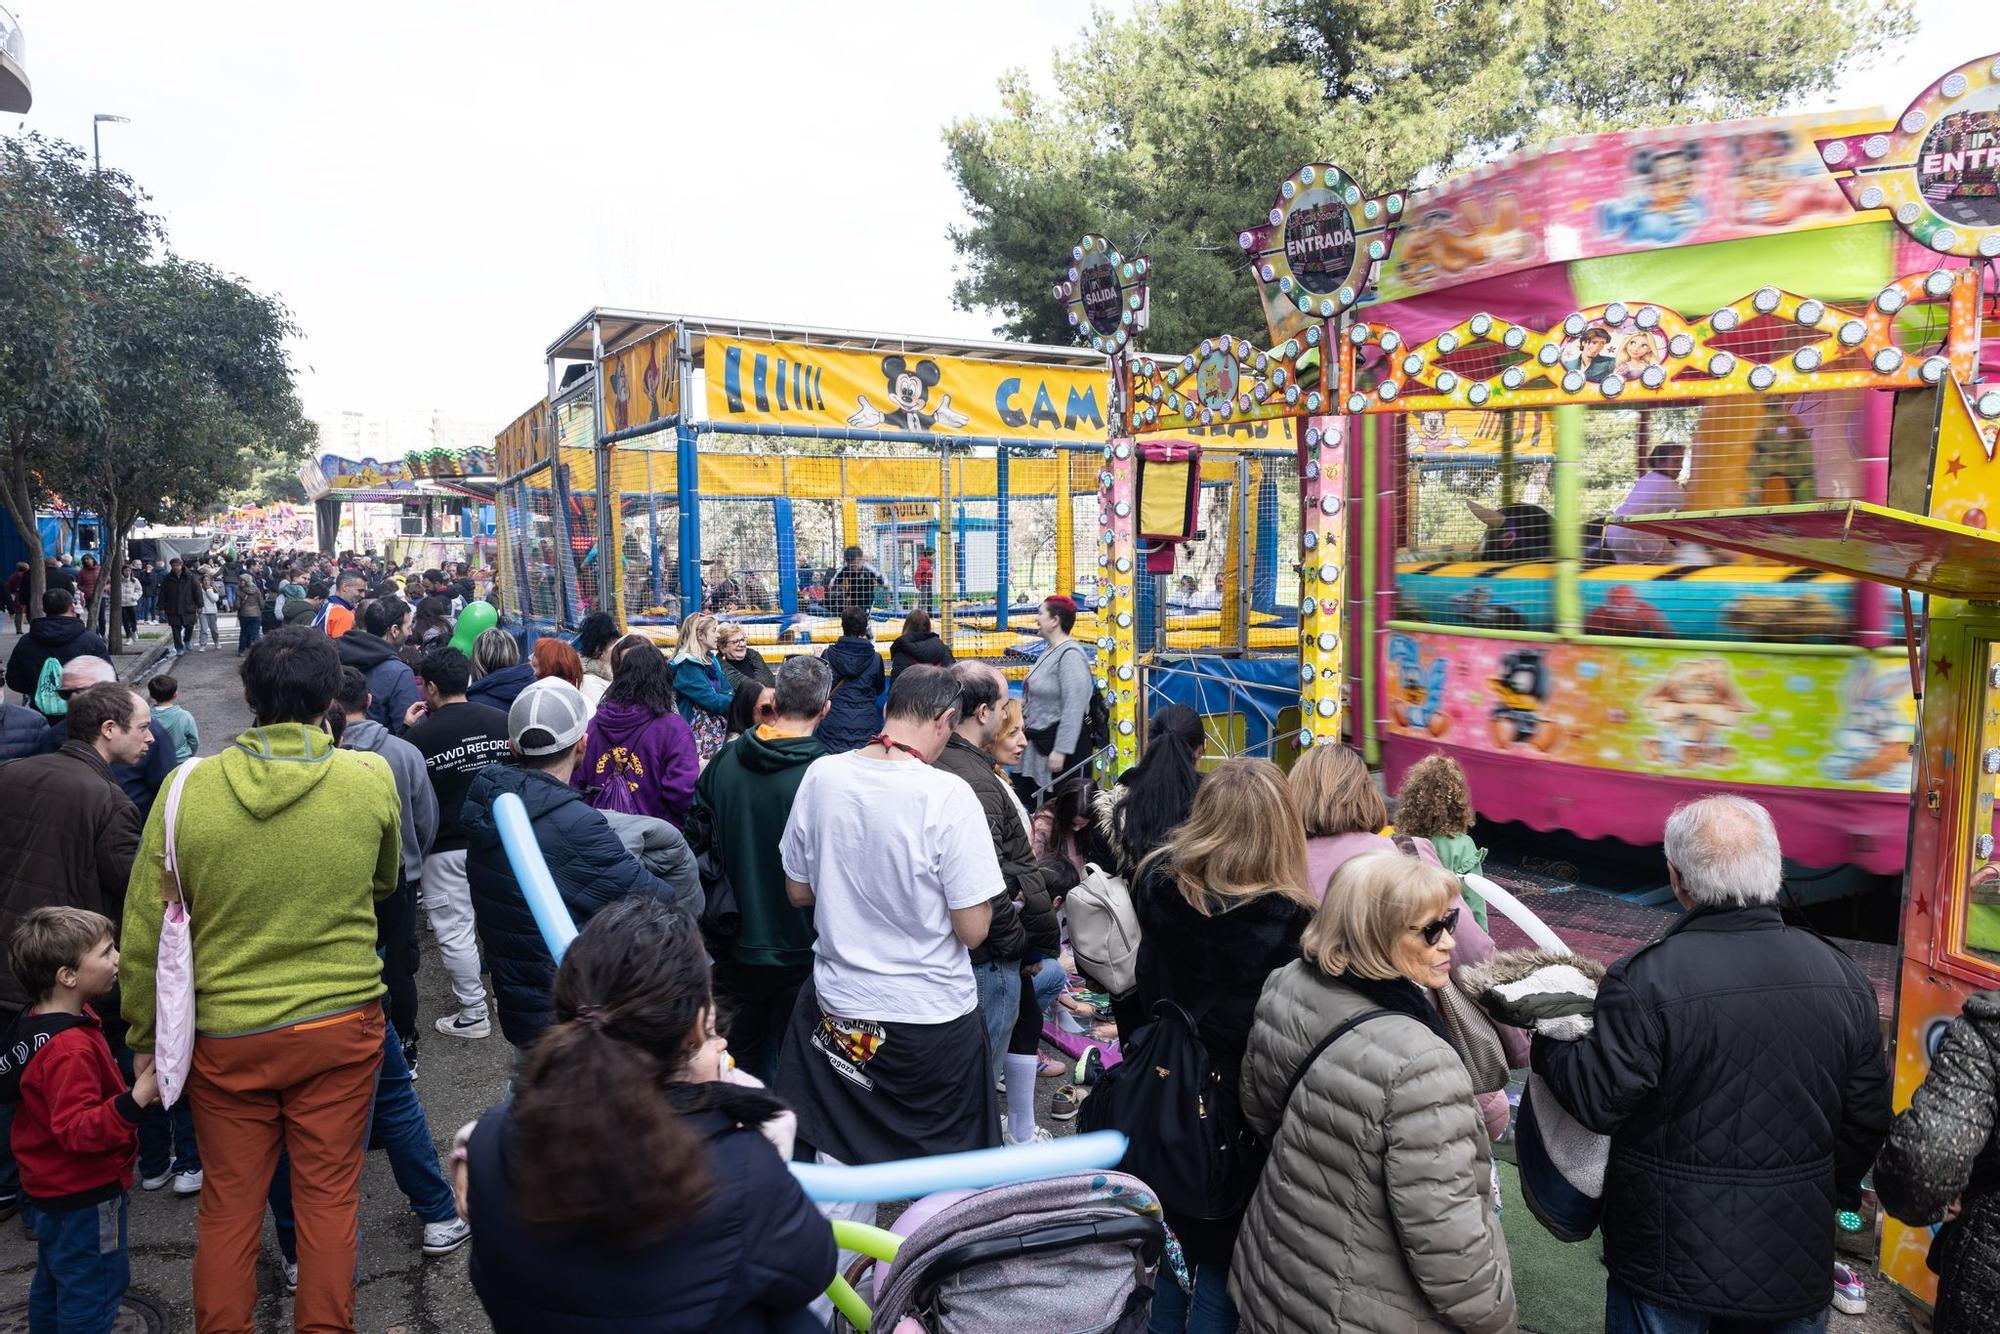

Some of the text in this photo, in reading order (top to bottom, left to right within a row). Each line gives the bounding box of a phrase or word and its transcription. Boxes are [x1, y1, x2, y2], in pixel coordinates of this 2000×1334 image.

[1287, 229, 1354, 256] ENTRADA
[1086, 287, 1118, 305] SALIDA
[995, 377, 1105, 431] CAM
[426, 746, 465, 767] STWD
[828, 1055, 855, 1075] ragoza
